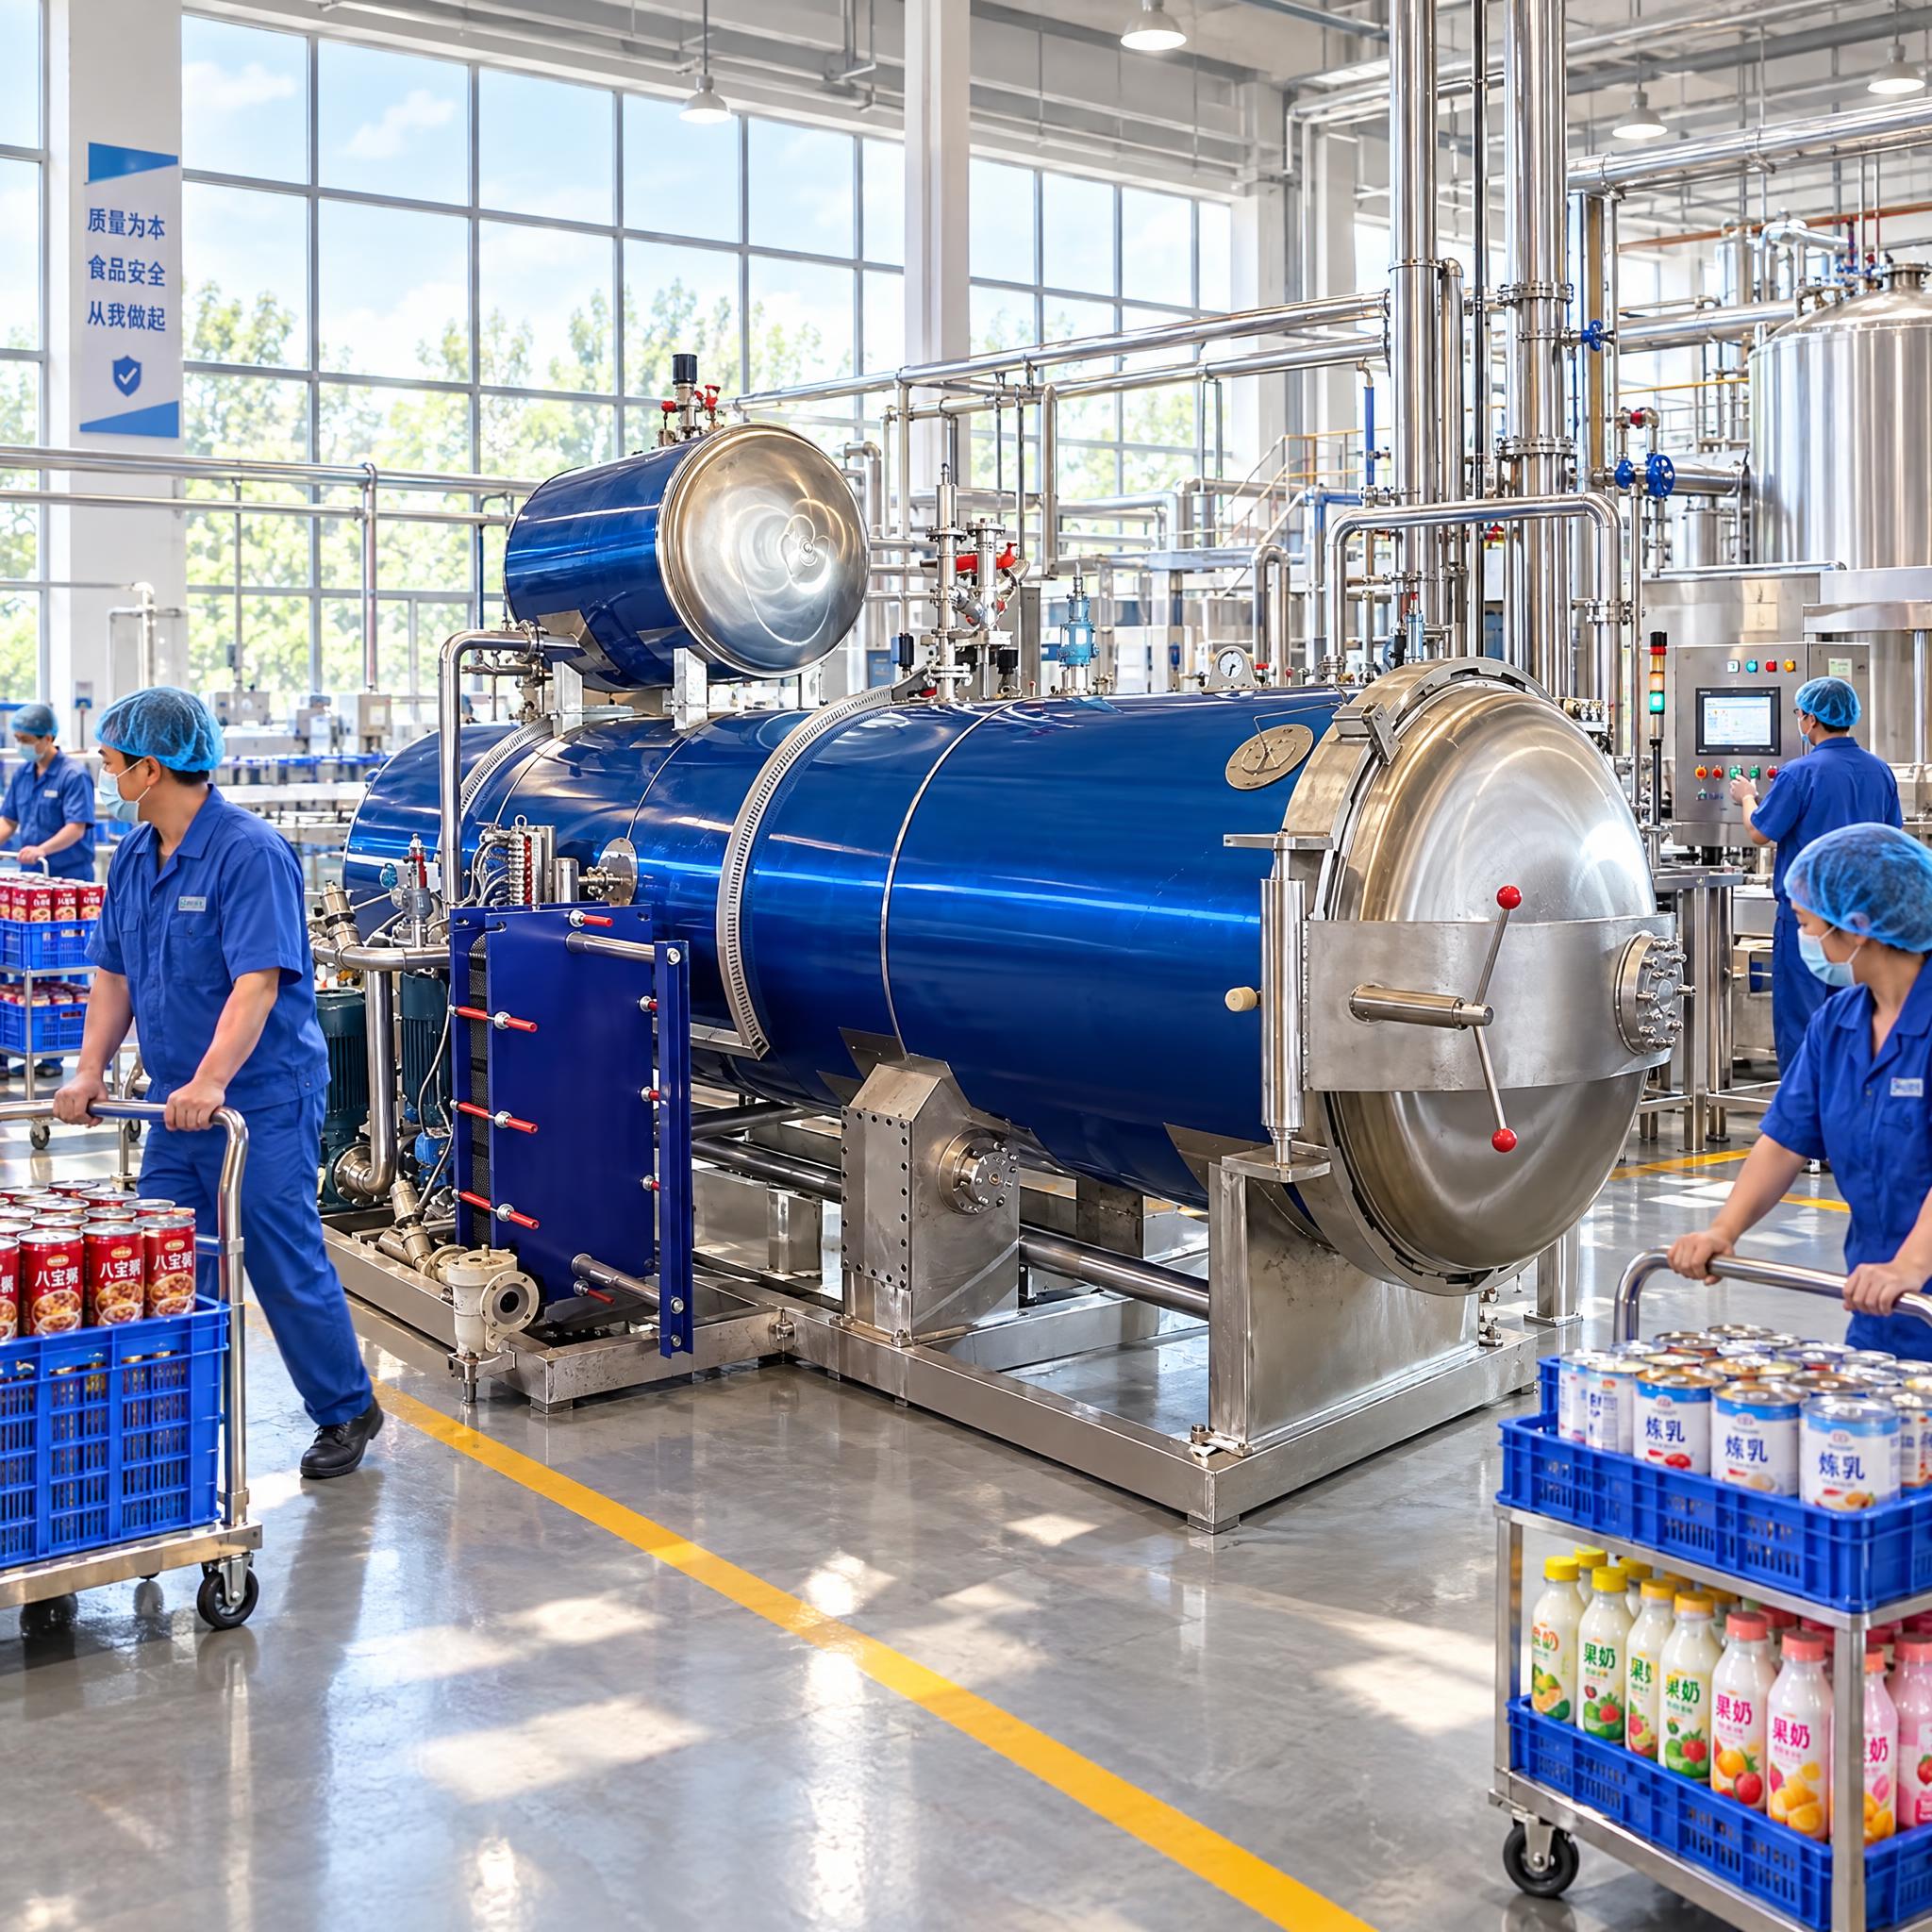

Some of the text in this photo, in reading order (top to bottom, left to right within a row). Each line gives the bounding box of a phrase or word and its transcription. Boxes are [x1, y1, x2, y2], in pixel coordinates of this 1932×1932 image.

[88, 208, 165, 241] 质量为本
[88, 254, 165, 287] 食品安全
[88, 300, 166, 332] 从我做起
[1645, 1416, 1686, 1442] 炼乳
[1725, 1434, 1769, 1462] 炼乳
[1819, 1451, 1866, 1480] 炼乳
[1584, 1641, 1616, 1670] 果奶
[1665, 1674, 1701, 1704] 果奶
[1716, 1693, 1753, 1726] 果奶
[1773, 1716, 1810, 1750] 果奶
